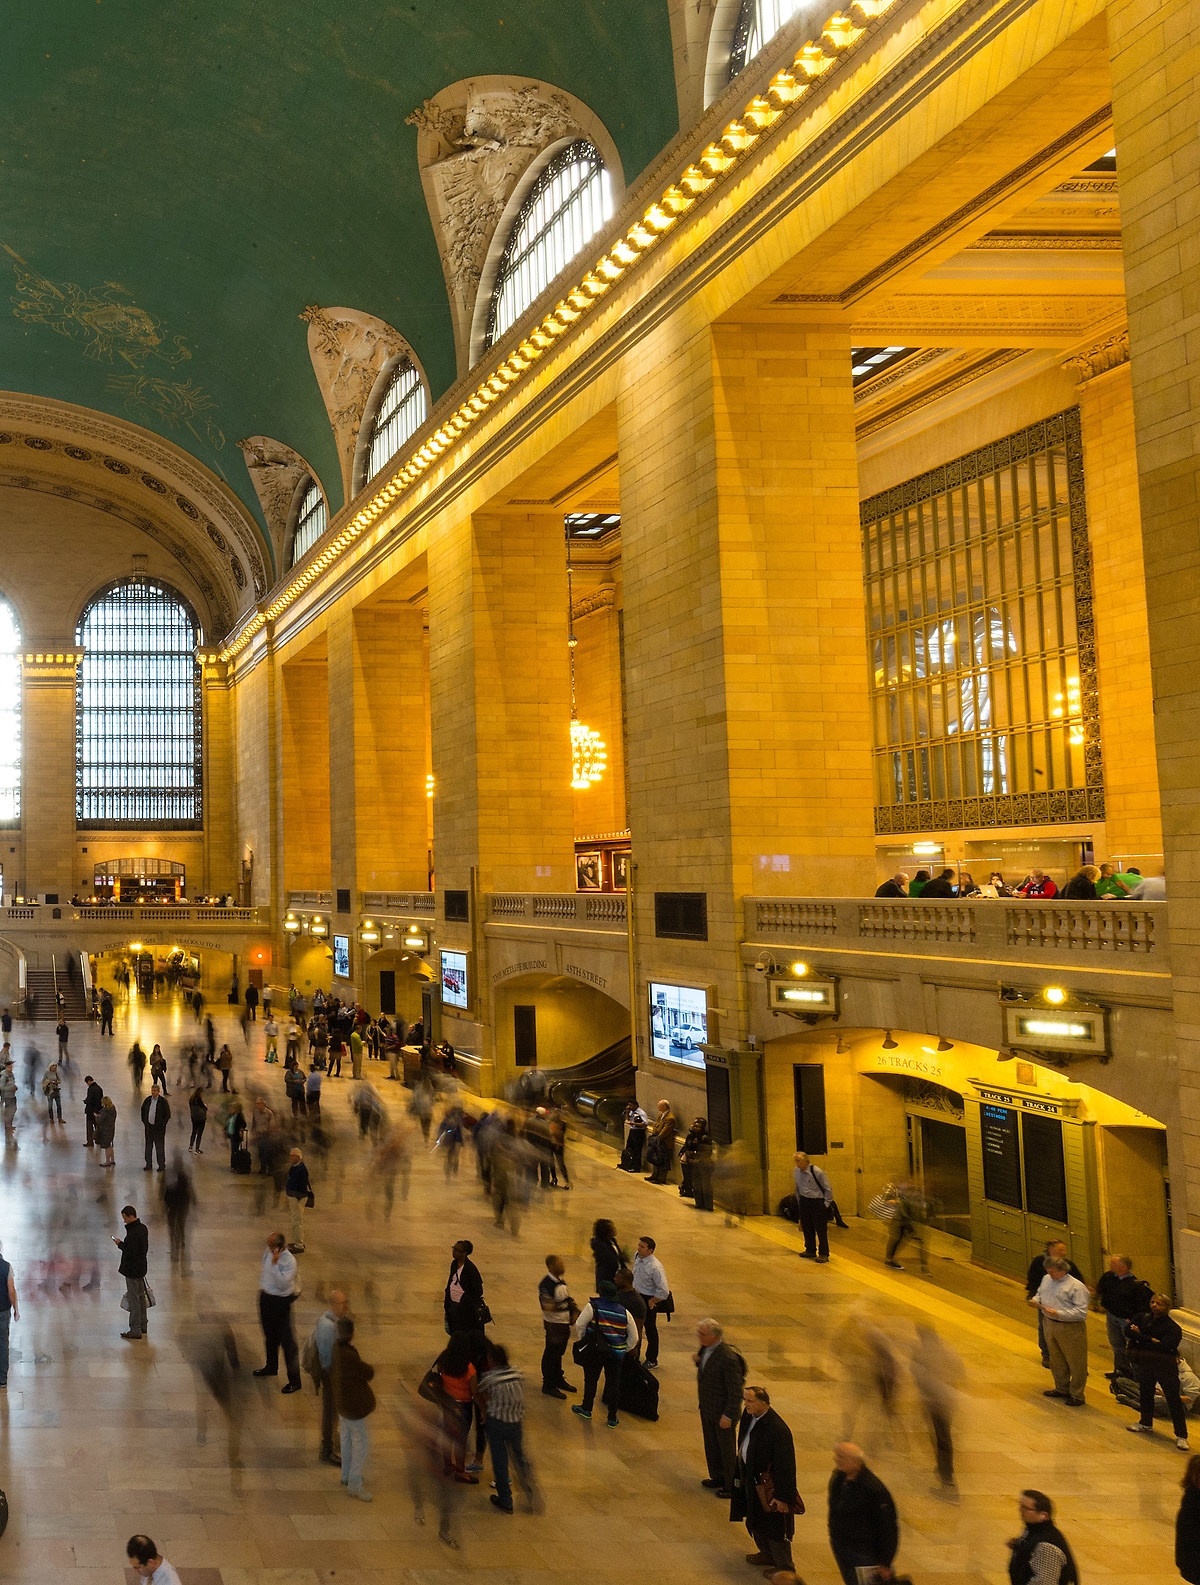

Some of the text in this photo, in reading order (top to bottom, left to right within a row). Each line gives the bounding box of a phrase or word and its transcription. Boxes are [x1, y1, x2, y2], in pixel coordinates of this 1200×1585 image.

[522, 960, 547, 971] BUILDING
[565, 964, 608, 989] 45TH STREET
[877, 1056, 942, 1077] 26 TRACKS 25
[983, 1092, 1002, 1101] TRACK
[1025, 1101, 1046, 1111] TRACK
